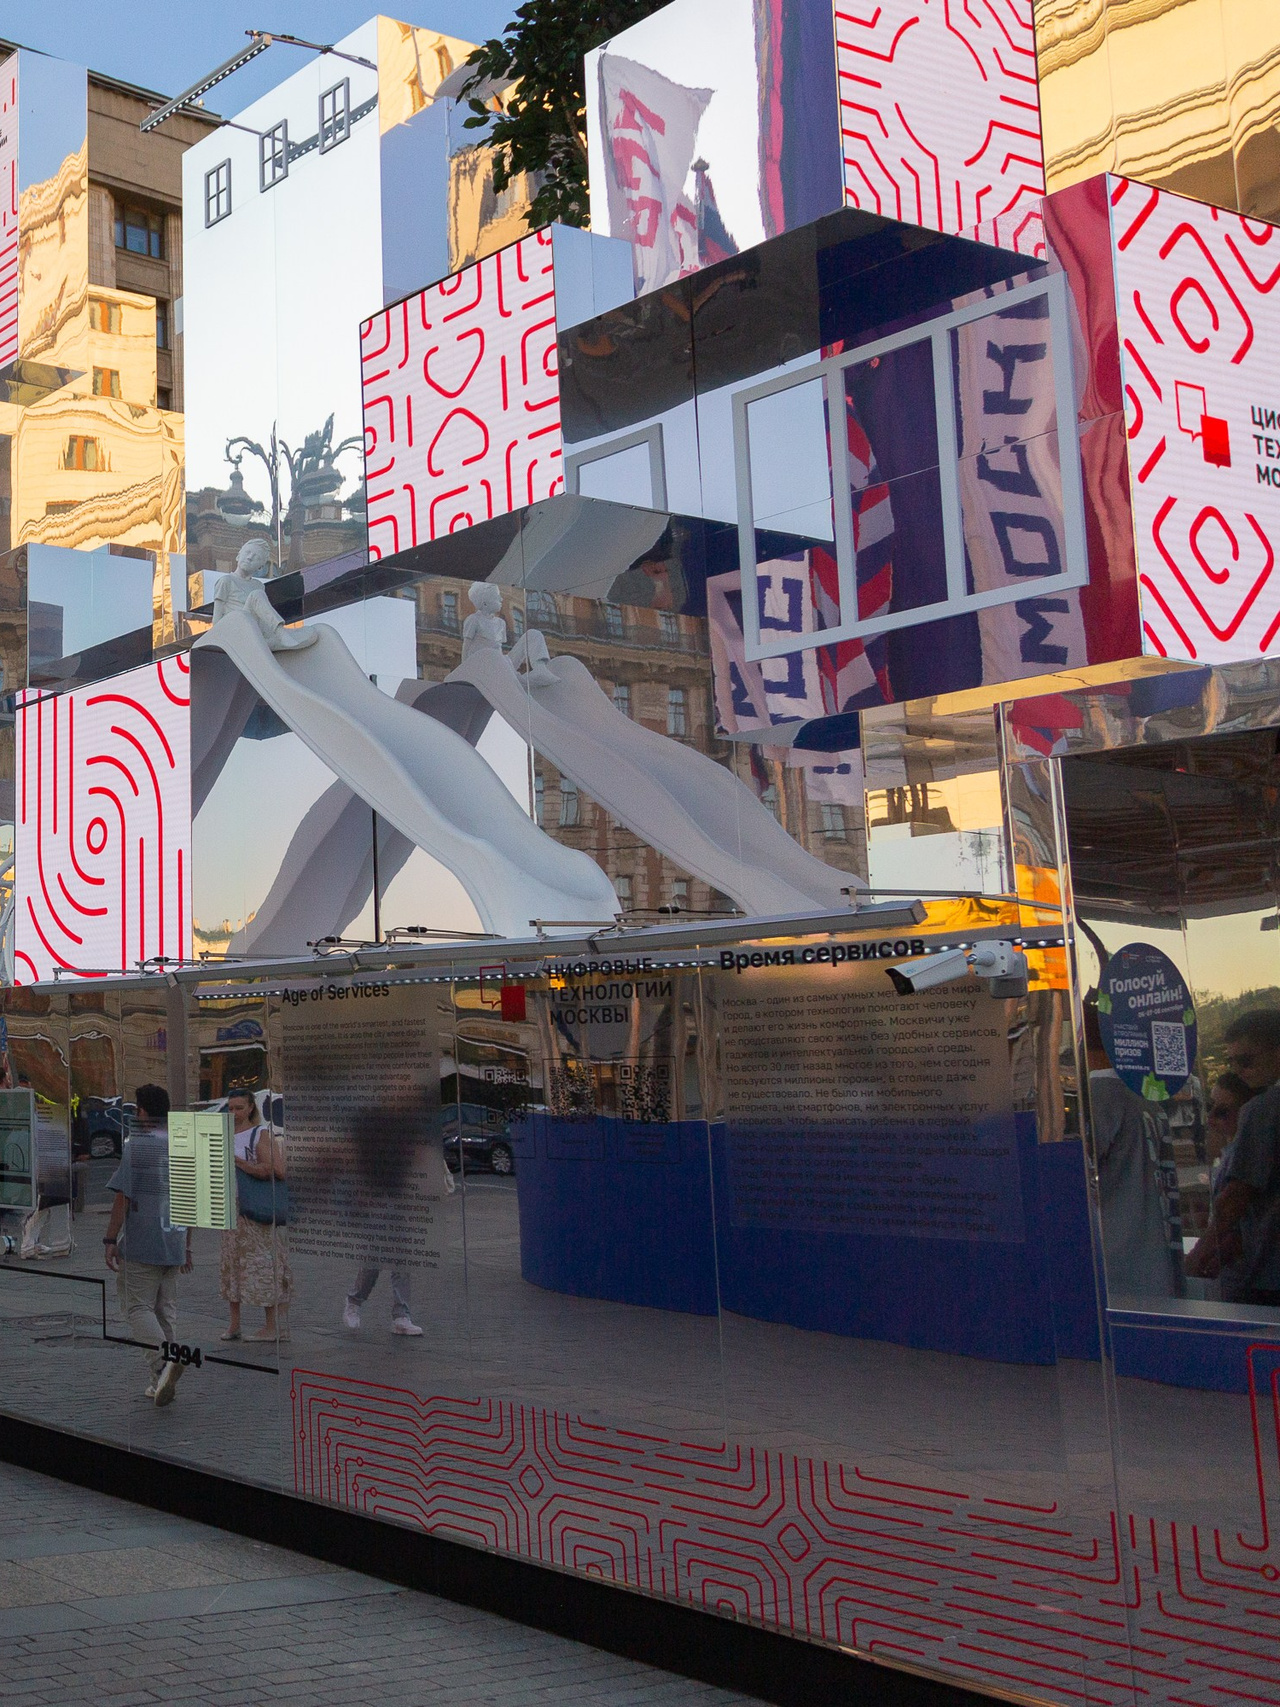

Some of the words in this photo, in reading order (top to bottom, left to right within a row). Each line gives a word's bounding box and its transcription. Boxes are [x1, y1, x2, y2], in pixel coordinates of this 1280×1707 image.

[720, 950, 795, 974] Время
[802, 939, 925, 968] сервисов
[548, 958, 652, 980] ЦИФРОВЫЕ
[548, 981, 672, 1002] ТЕХНОЛОГИИ
[1109, 969, 1165, 994] Голосуй
[282, 988, 307, 1006] Age
[310, 986, 324, 1001] of
[328, 984, 390, 1000] Services
[1128, 984, 1182, 1008] онлайн!
[550, 1008, 629, 1025] МОСКВЫ
[161, 1341, 202, 1369] 1994
